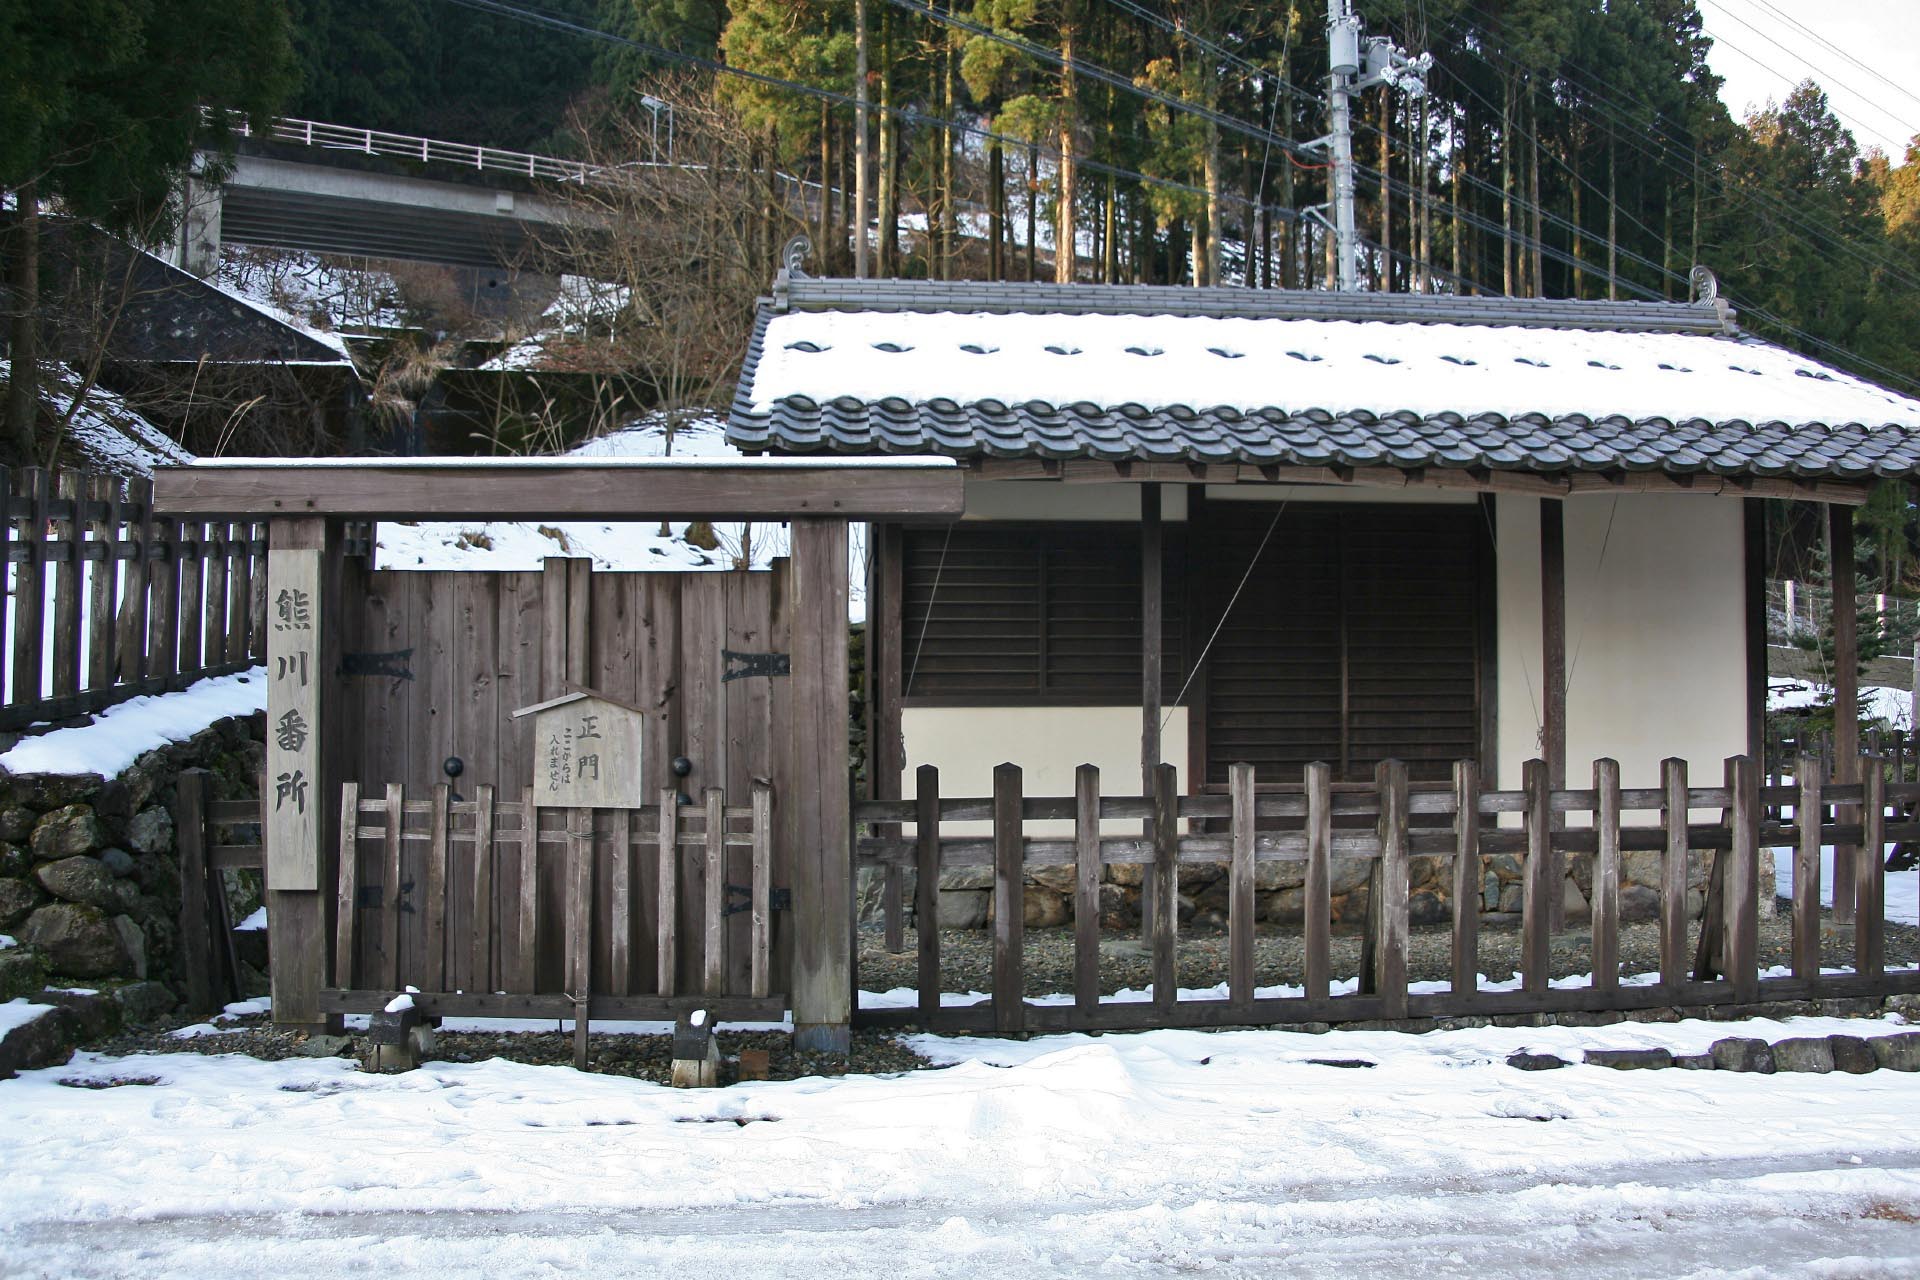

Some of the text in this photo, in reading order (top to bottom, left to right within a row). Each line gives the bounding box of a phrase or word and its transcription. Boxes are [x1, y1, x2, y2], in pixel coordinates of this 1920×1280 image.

[274, 588, 311, 816] 熊川番所
[549, 734, 560, 792] 入れません
[561, 727, 573, 784] ここからは
[576, 715, 602, 781] 正門
